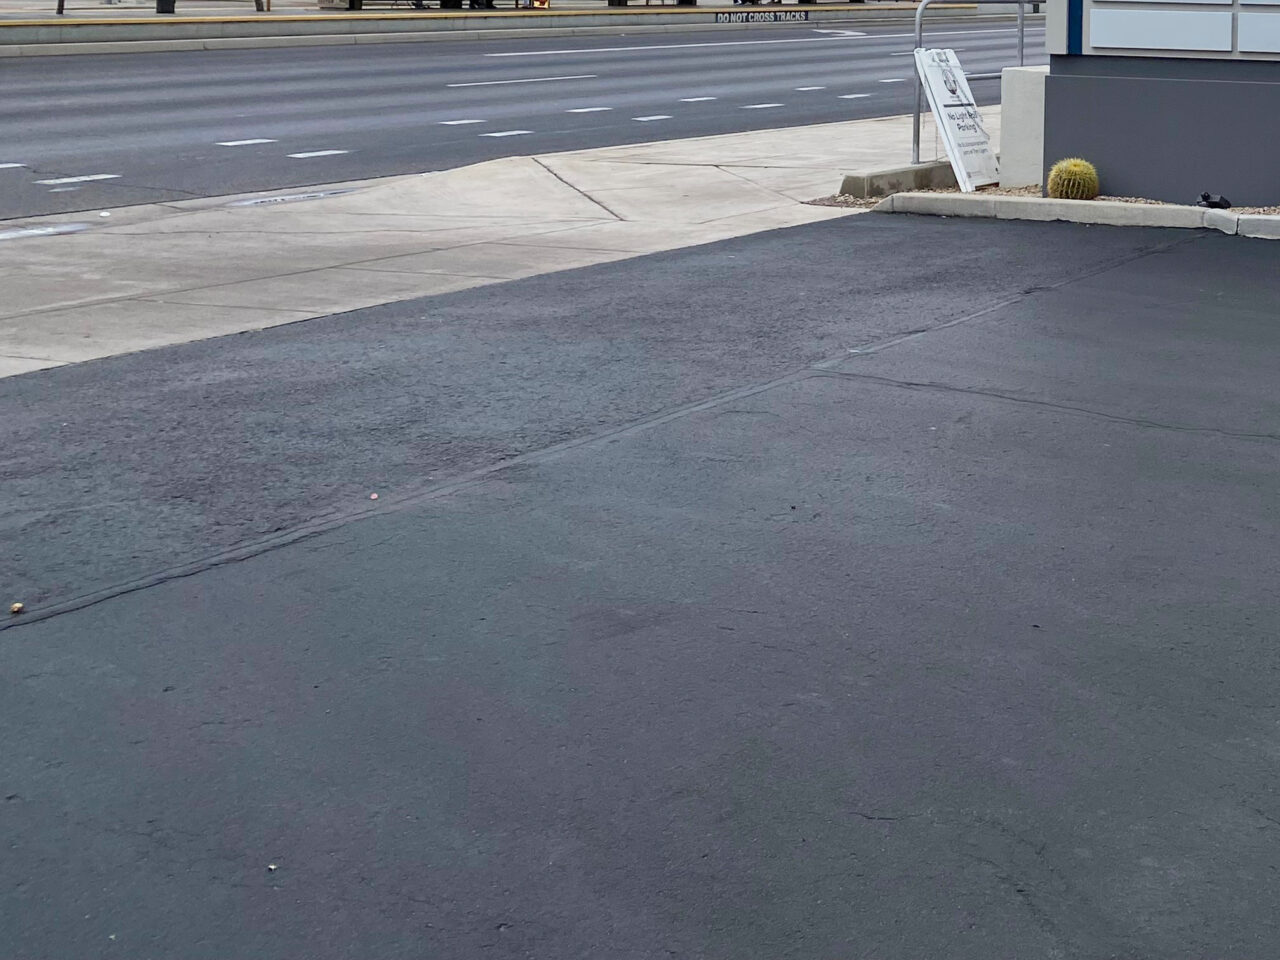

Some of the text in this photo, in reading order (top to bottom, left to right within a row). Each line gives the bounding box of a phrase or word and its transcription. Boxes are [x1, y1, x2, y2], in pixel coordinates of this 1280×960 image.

[717, 11, 806, 23] DO NOT CROSS TRACKS
[947, 112, 956, 120] No
[957, 123, 977, 133] Parking
